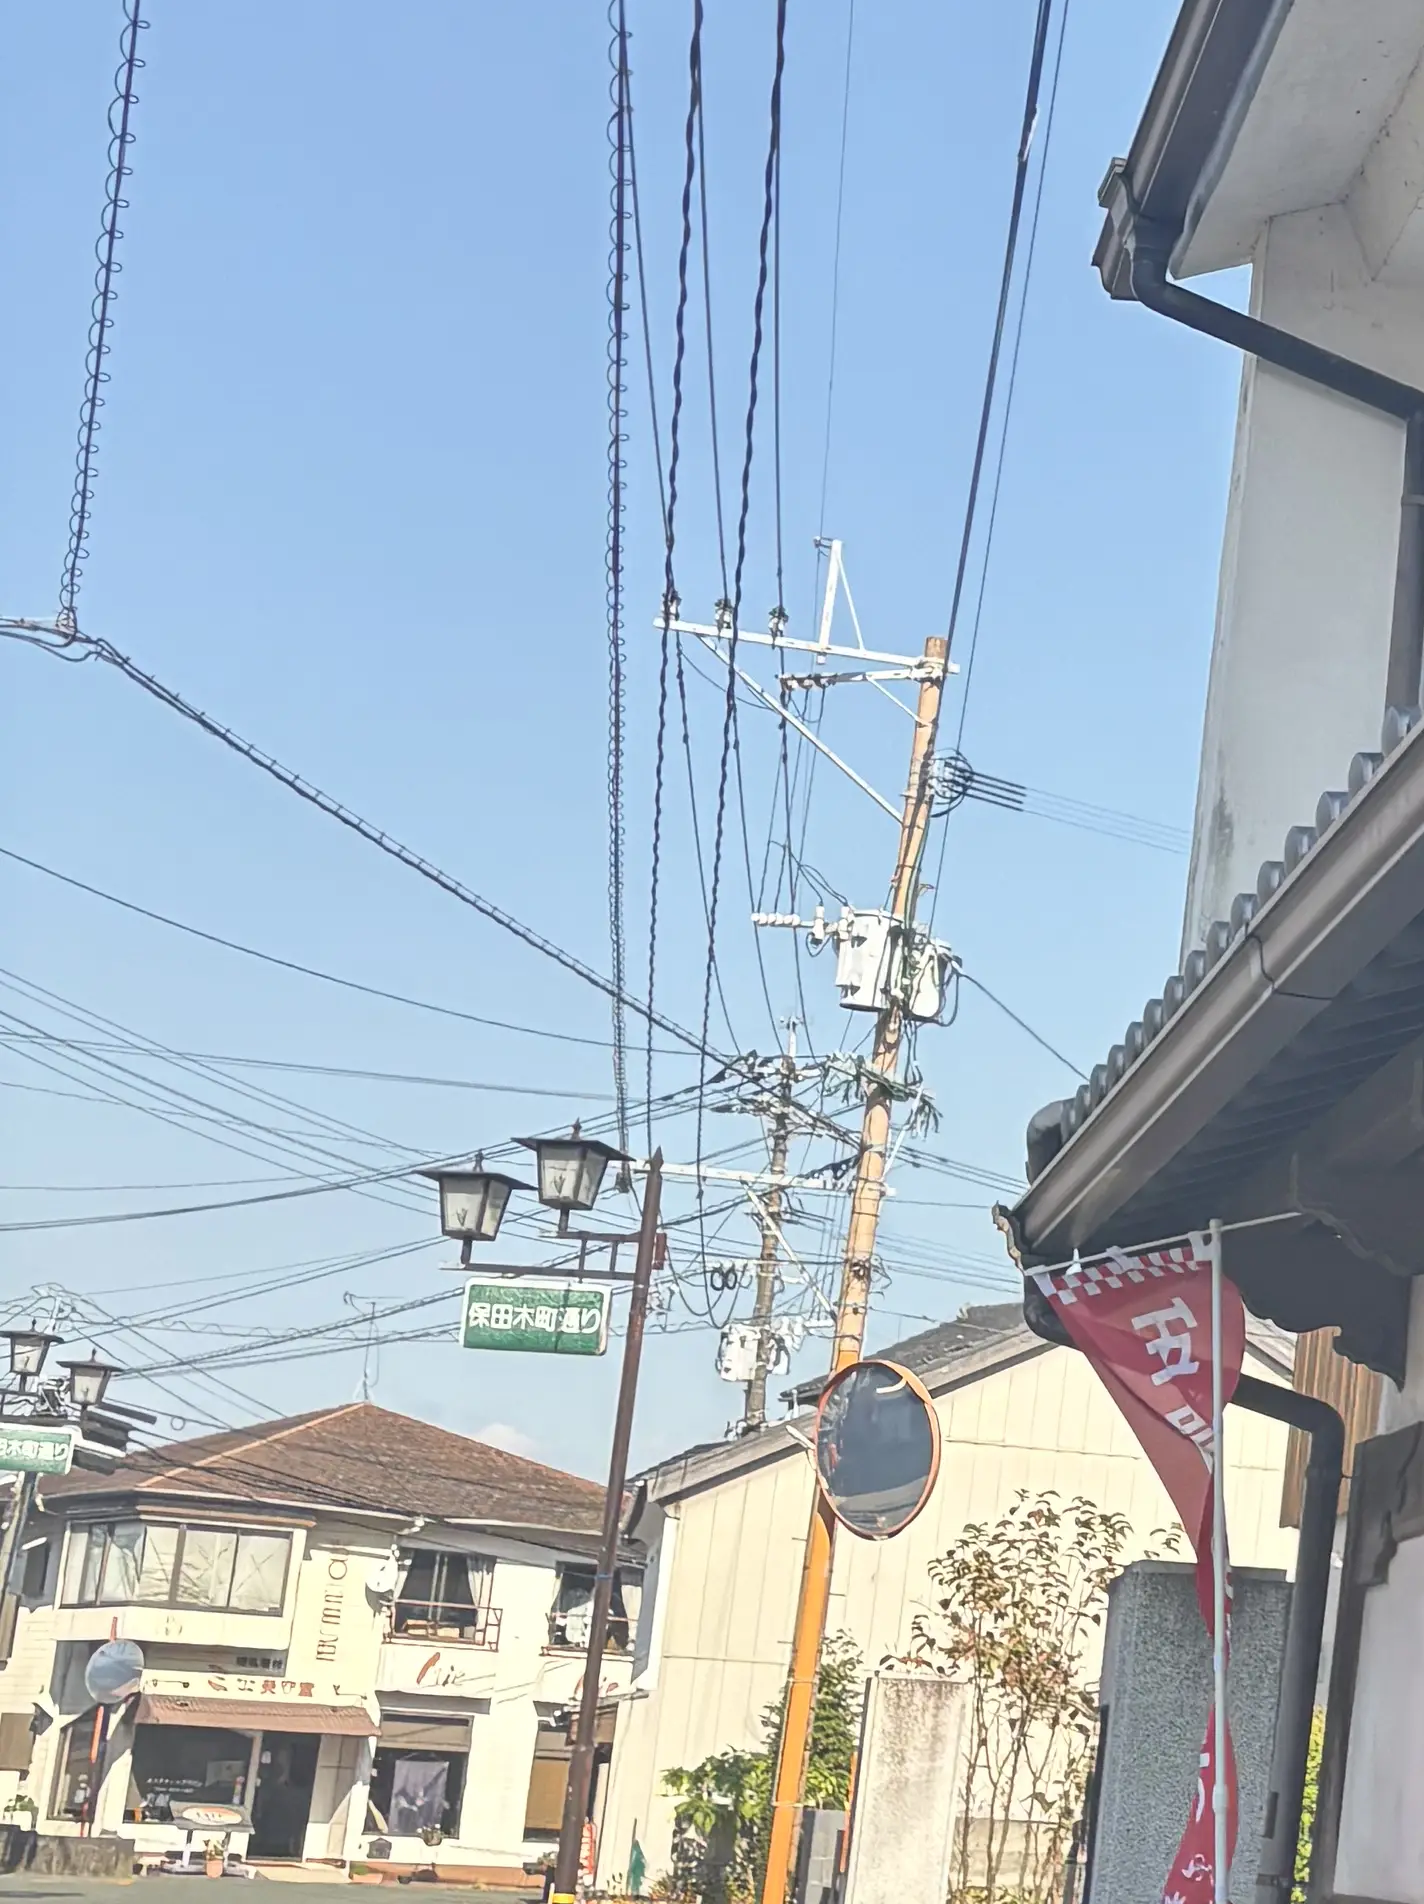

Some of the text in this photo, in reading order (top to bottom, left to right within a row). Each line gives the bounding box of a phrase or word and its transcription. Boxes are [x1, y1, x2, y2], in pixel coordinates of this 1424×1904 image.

[469, 1303, 601, 1334] 保田木町通り
